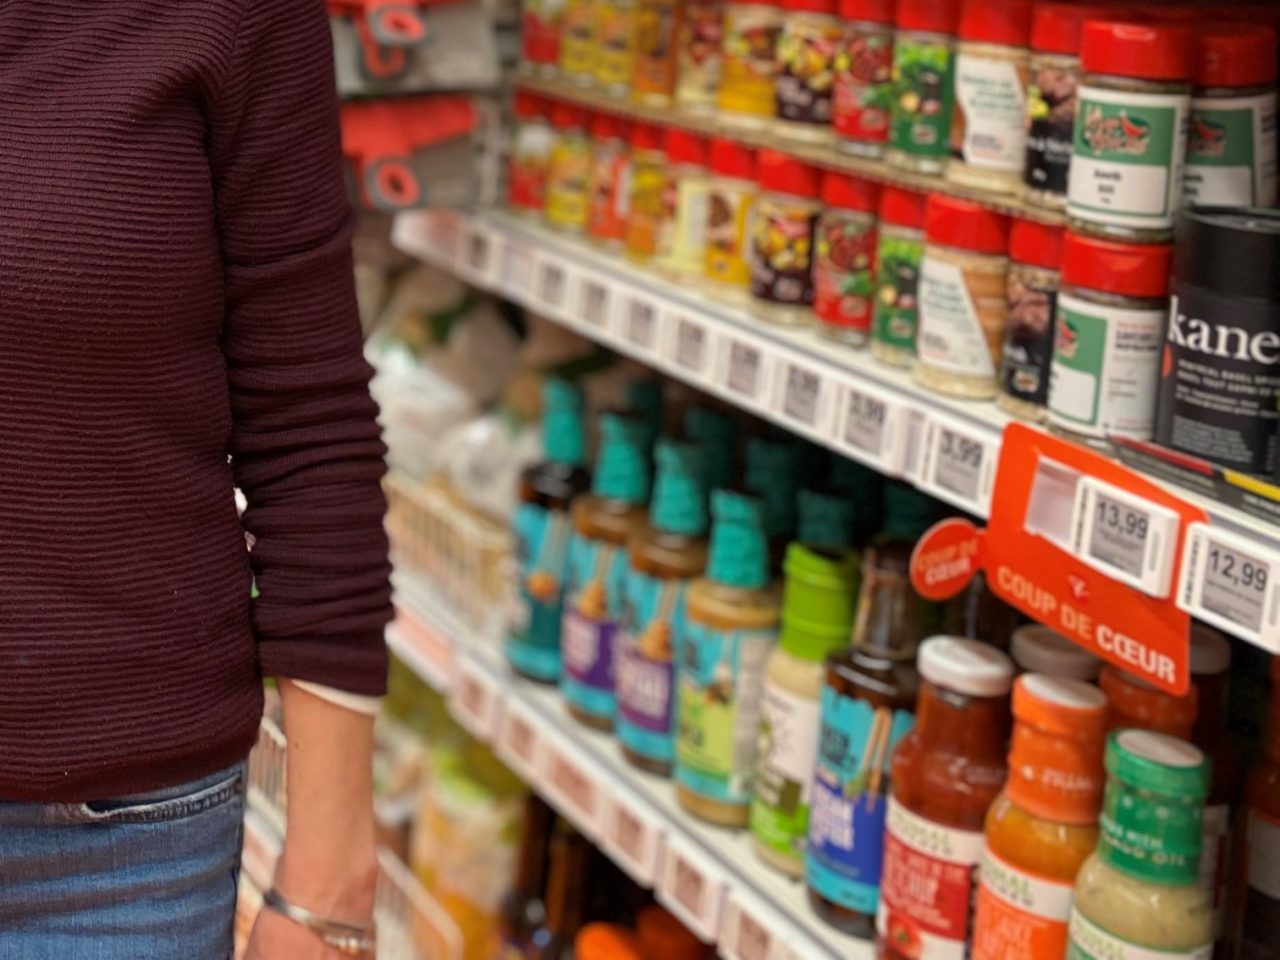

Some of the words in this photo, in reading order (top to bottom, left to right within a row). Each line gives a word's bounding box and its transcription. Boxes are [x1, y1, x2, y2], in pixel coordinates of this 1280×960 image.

[1097, 500, 1150, 540] 13,99
[1210, 549, 1268, 592] 12,99
[997, 565, 1057, 613] COUP
[1060, 604, 1093, 640] DE
[1095, 624, 1177, 685] CŒUR
